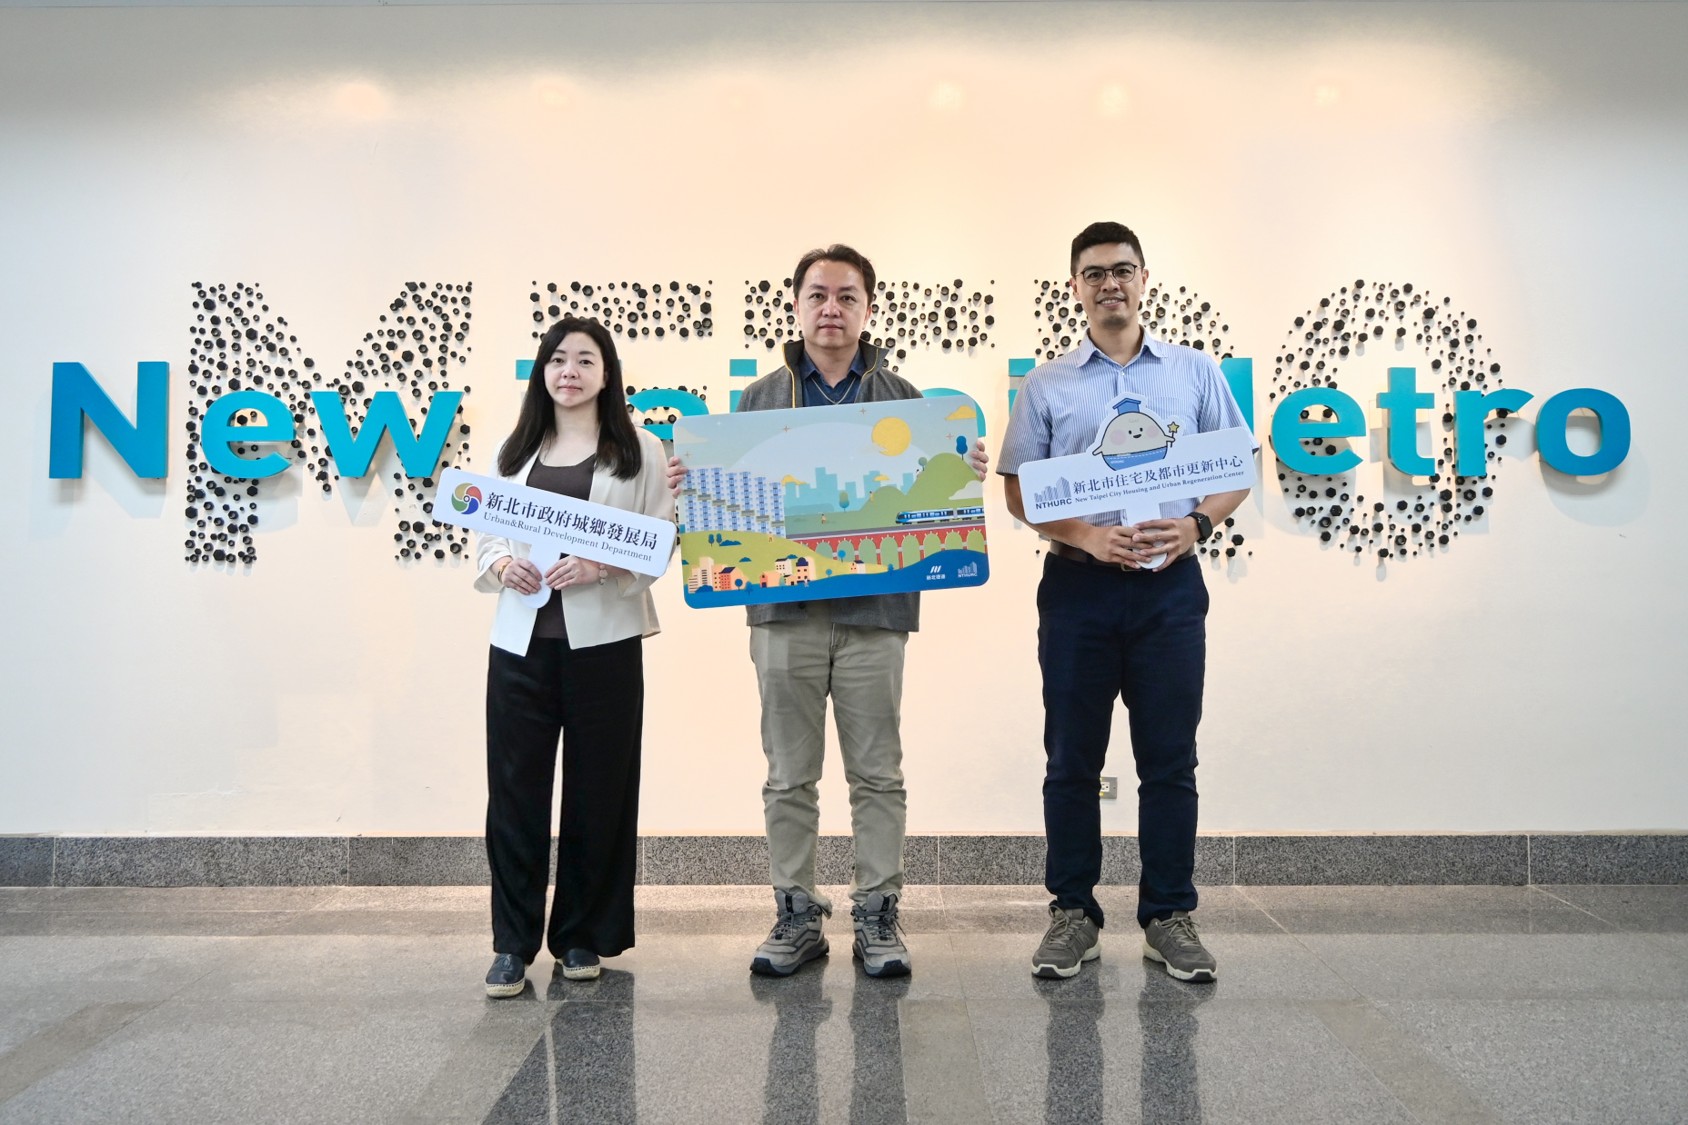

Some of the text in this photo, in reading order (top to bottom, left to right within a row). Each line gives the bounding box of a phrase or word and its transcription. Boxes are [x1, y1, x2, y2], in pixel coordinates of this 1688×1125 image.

[49, 361, 464, 479] New
[1220, 357, 1631, 477] etro
[1073, 455, 1243, 495] 新北市住宅及都市更新中心
[1089, 492, 1108, 502] Taipei
[1109, 490, 1122, 500] City
[1123, 486, 1149, 497] Housing
[1149, 483, 1161, 491] and
[1162, 480, 1182, 489] Urban
[1182, 474, 1223, 486] Regeneration
[1224, 470, 1245, 480] Center
[485, 491, 657, 550] 新北市政府城鄉發展局
[1035, 498, 1072, 510] NTHURC
[483, 511, 652, 562] Urban&Rural Development Department
